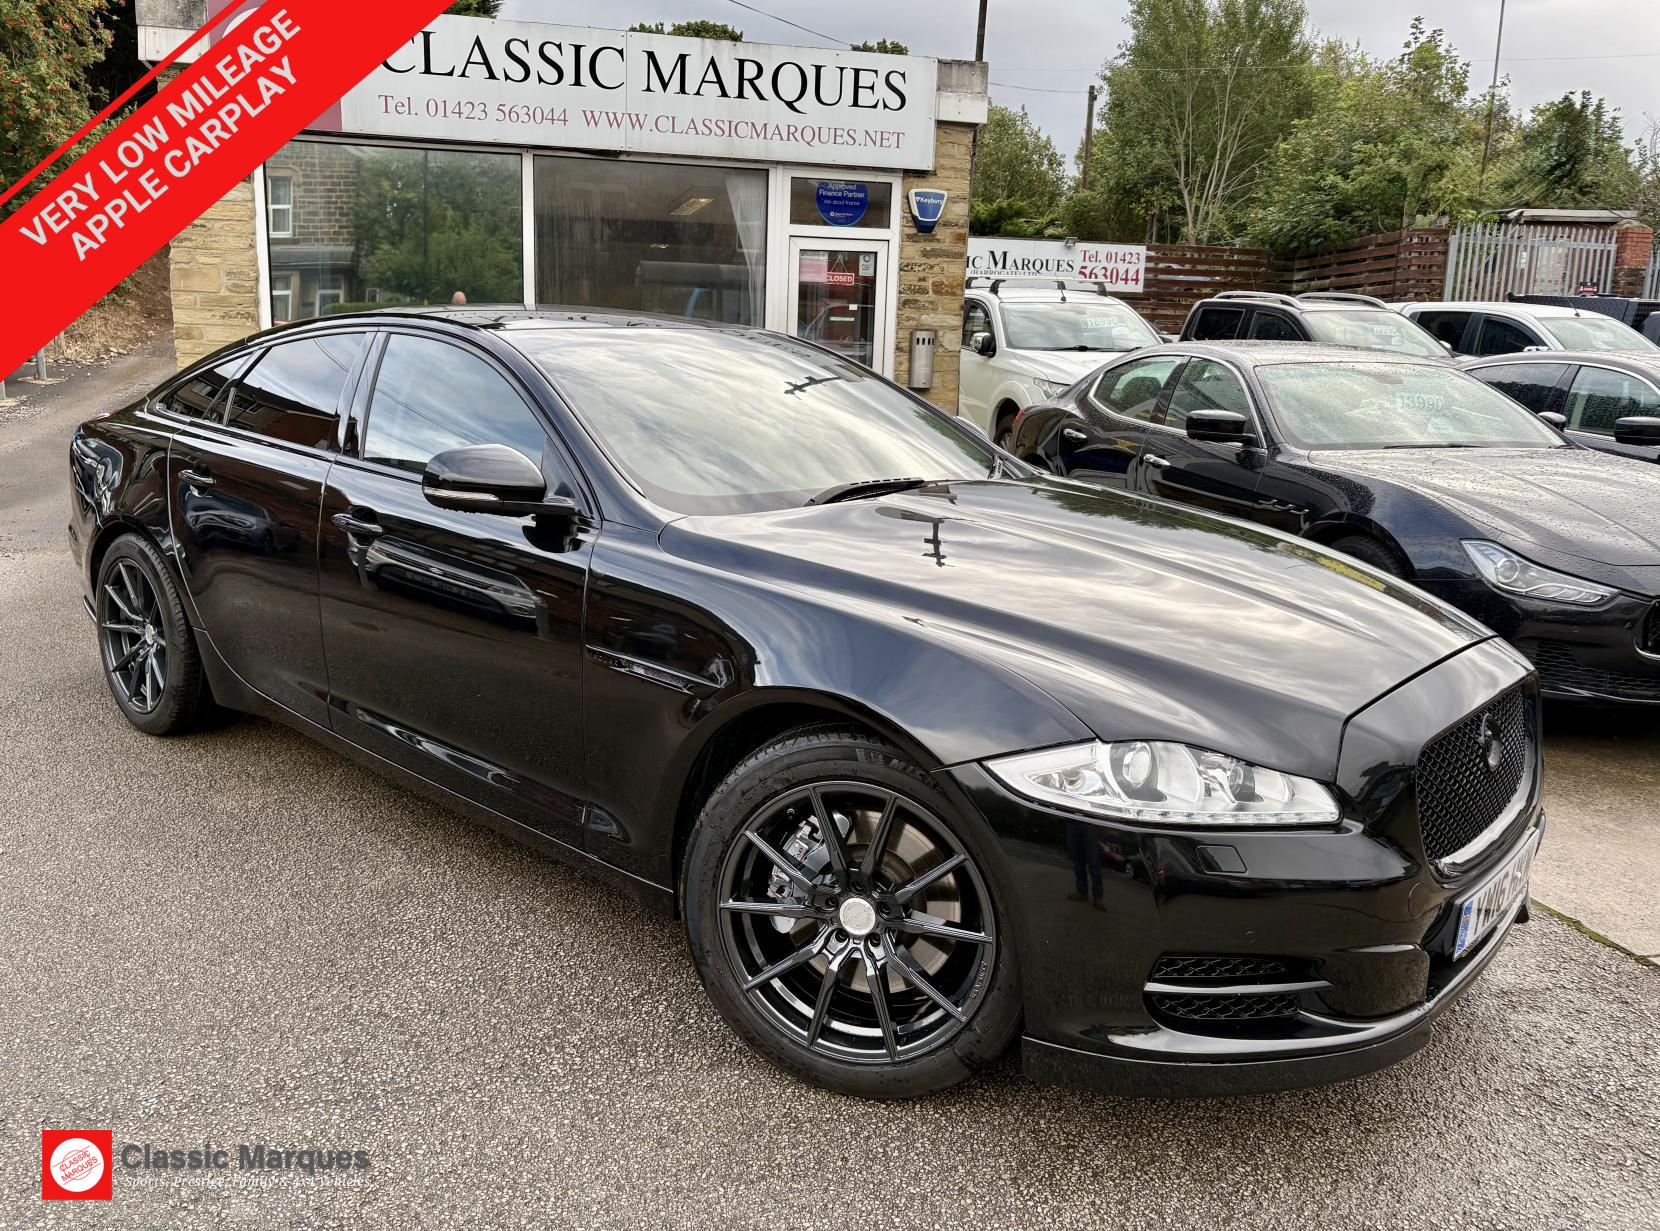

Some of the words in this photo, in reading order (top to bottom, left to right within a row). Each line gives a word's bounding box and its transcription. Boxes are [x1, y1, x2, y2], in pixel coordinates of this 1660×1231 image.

[641, 49, 907, 115] MARQUES
[378, 94, 418, 117] Tel.
[426, 98, 488, 121] 01423
[496, 103, 569, 126] 563044
[582, 109, 906, 149] WWW.CLASSICMARQUES.NET
[819, 189, 843, 197] Finance
[827, 182, 857, 191] Approved
[986, 250, 1074, 274] MARQUES
[1080, 249, 1102, 263] Tel.
[1105, 250, 1141, 265] 01423
[1078, 265, 1140, 285] 563044
